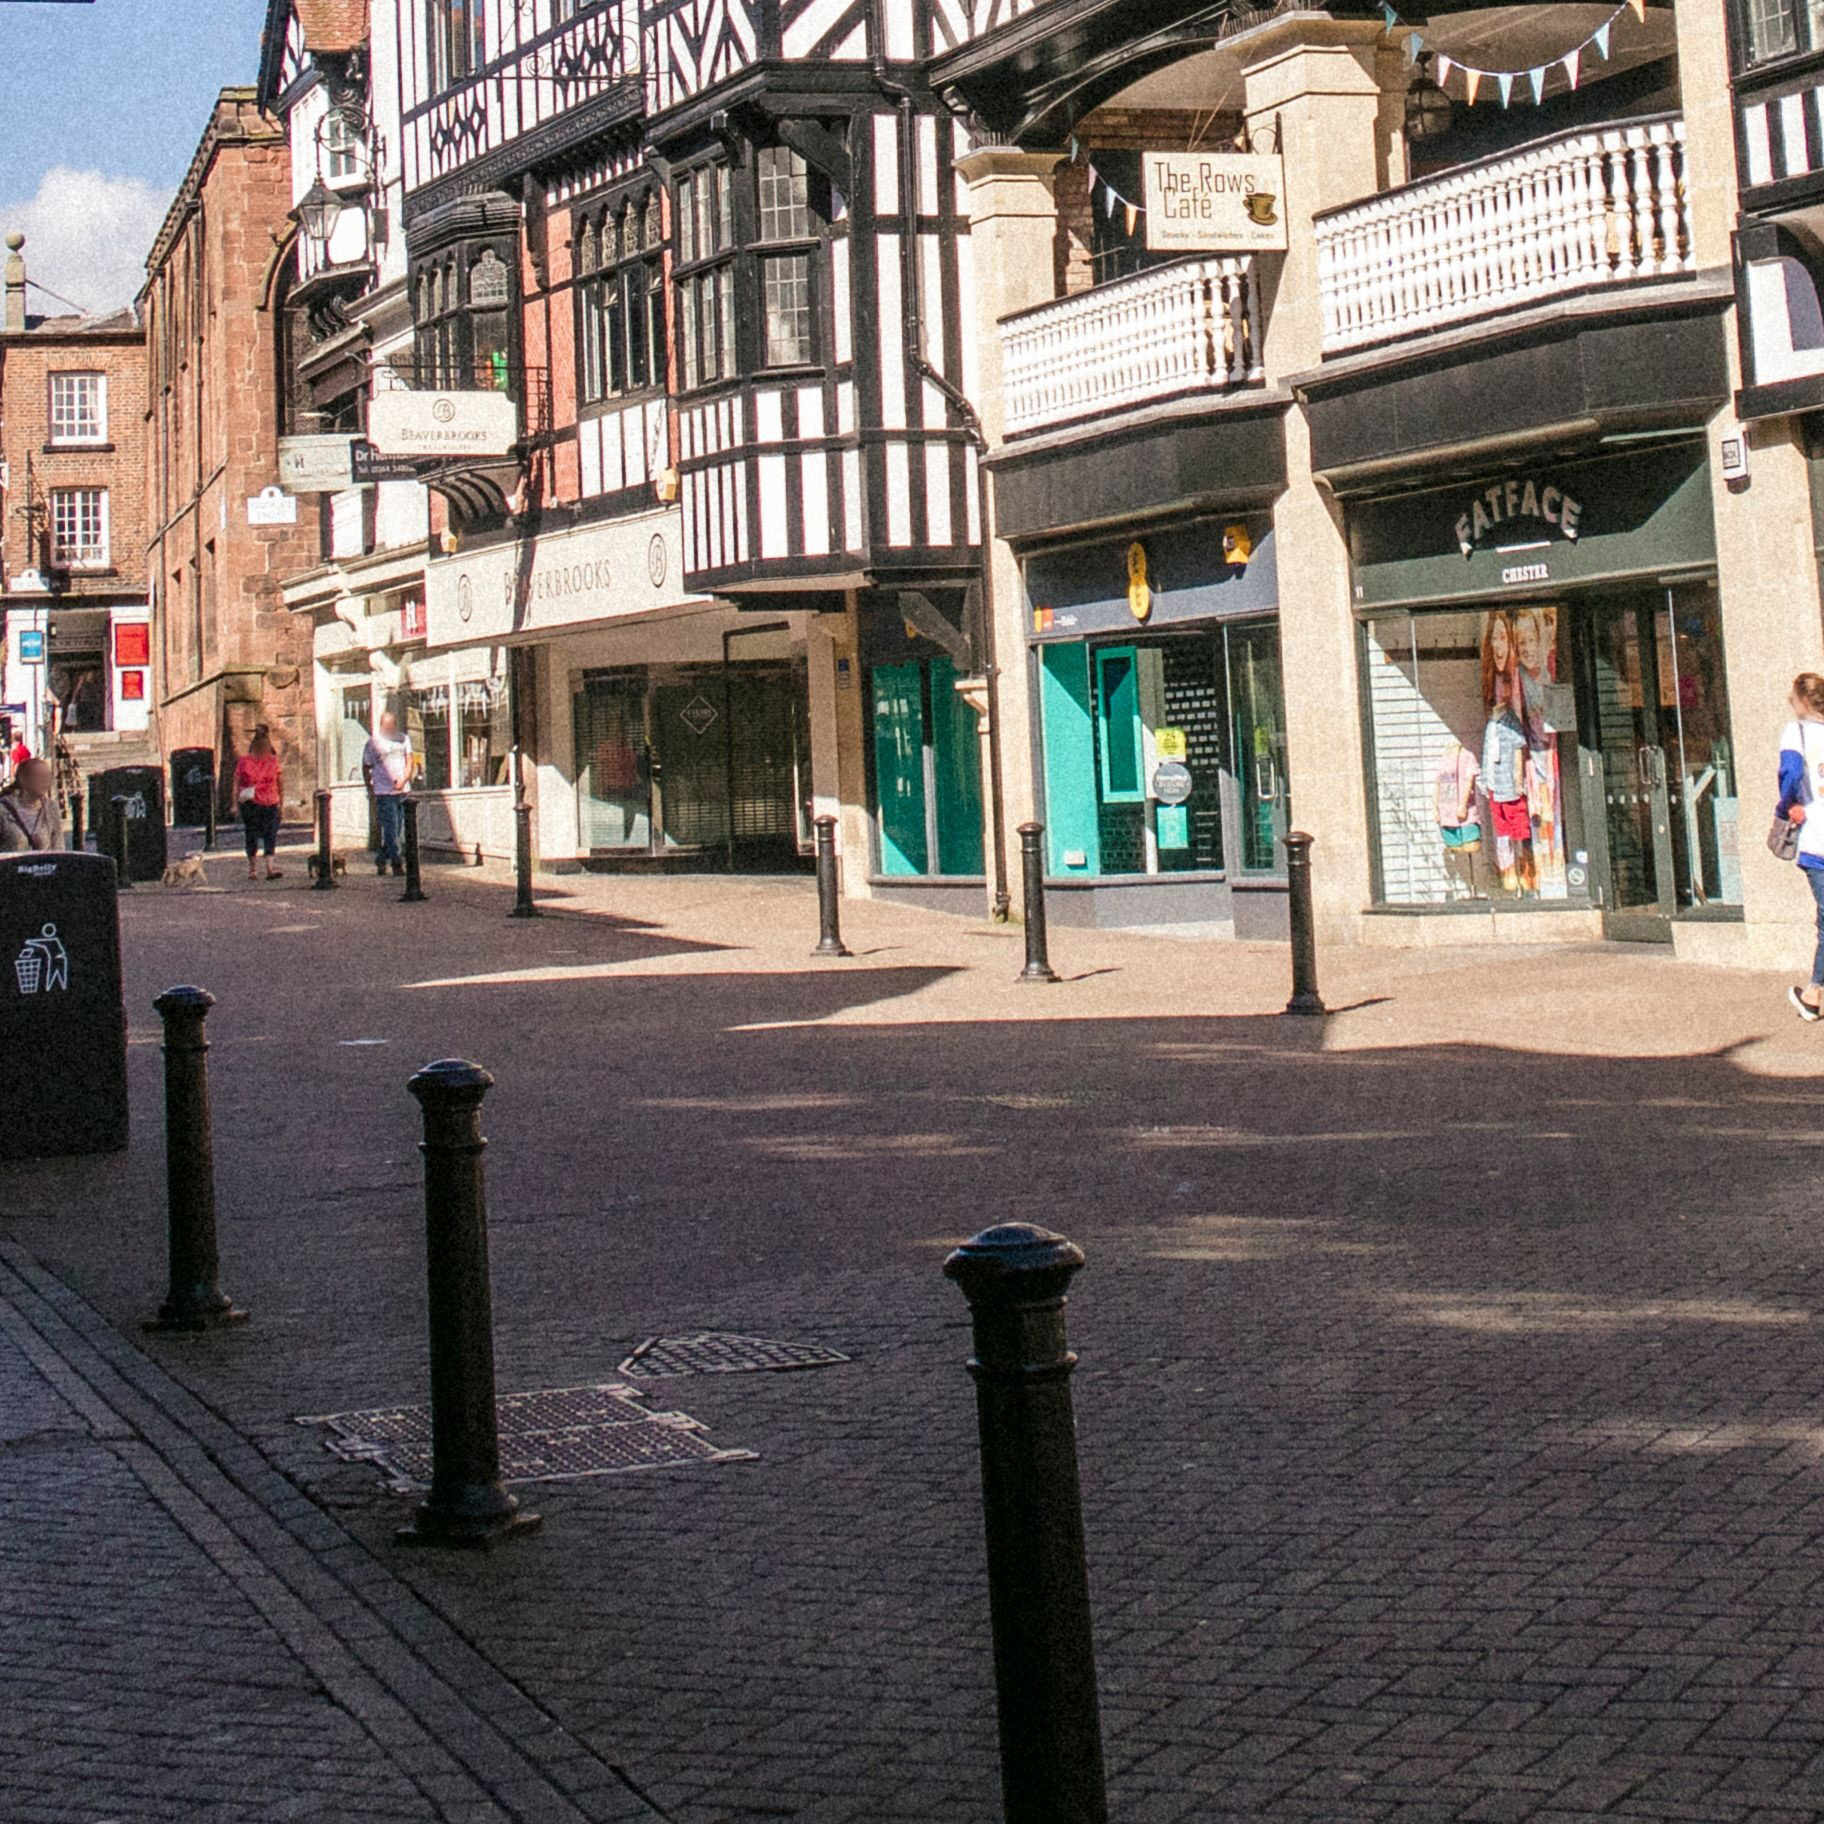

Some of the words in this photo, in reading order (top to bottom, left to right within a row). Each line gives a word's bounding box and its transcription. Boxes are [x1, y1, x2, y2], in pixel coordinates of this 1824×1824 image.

[1154, 161, 1191, 193] The
[1199, 162, 1256, 193] Rows
[1163, 186, 1213, 219] Café
[400, 429, 488, 442] BEAVERBROOKS
[1454, 479, 1582, 556] FATFACE
[504, 558, 612, 606] BVERBROOKS
[1501, 563, 1549, 584] CHESTER
[17, 862, 57, 874] BigBelly
